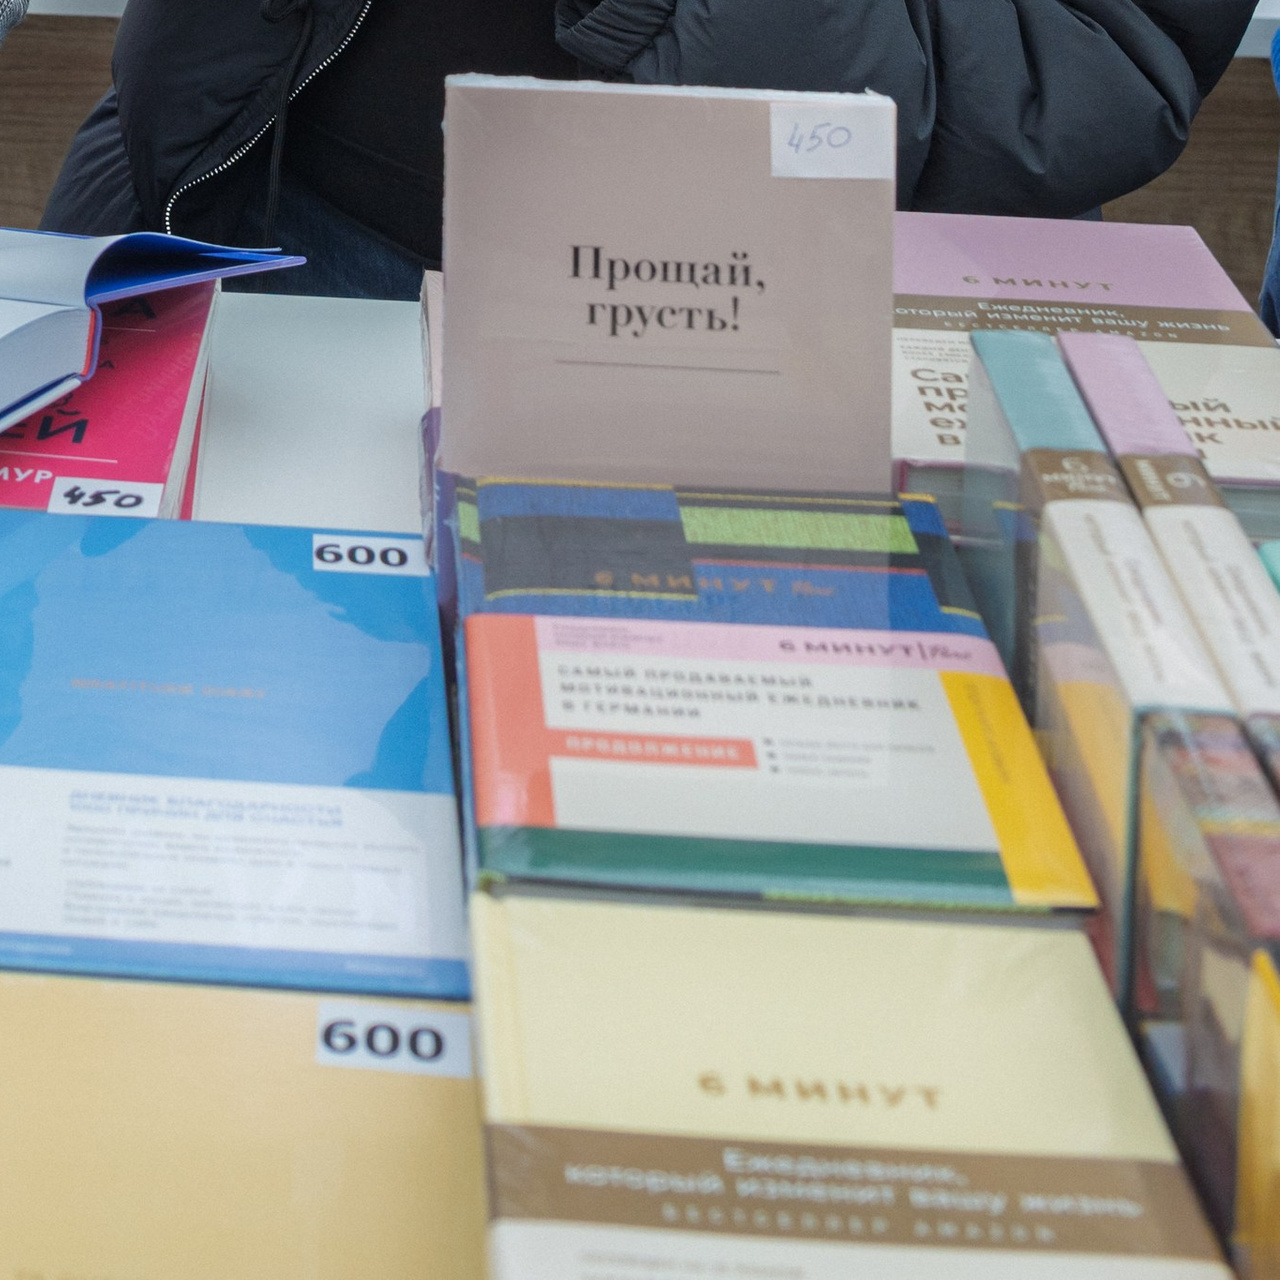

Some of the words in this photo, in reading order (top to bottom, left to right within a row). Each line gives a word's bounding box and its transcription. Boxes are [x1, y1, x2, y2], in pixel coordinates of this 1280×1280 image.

[786, 121, 852, 154] 450
[568, 244, 766, 294] Прощай,
[992, 276, 1115, 292] МИНУТ
[587, 296, 740, 338] грусть!
[892, 305, 978, 320] оторый
[986, 311, 1082, 325] изменит
[1091, 316, 1149, 330] вашу
[1157, 319, 1231, 333] жизнь
[977, 301, 1125, 318] Ежедневник,
[63, 485, 144, 508] 450
[314, 542, 410, 569] 600
[557, 662, 638, 679] САМЫЙ
[644, 668, 815, 689] ПРОДАВАЕМЫЙ
[560, 680, 760, 703] МОТИВАЦИОННЫЙ
[767, 691, 921, 711] ЕЖЕДНЕВНИК
[581, 701, 703, 718] ГЕРМАНИИ
[321, 1016, 447, 1063] 600
[747, 1076, 943, 1110] МИНУТ
